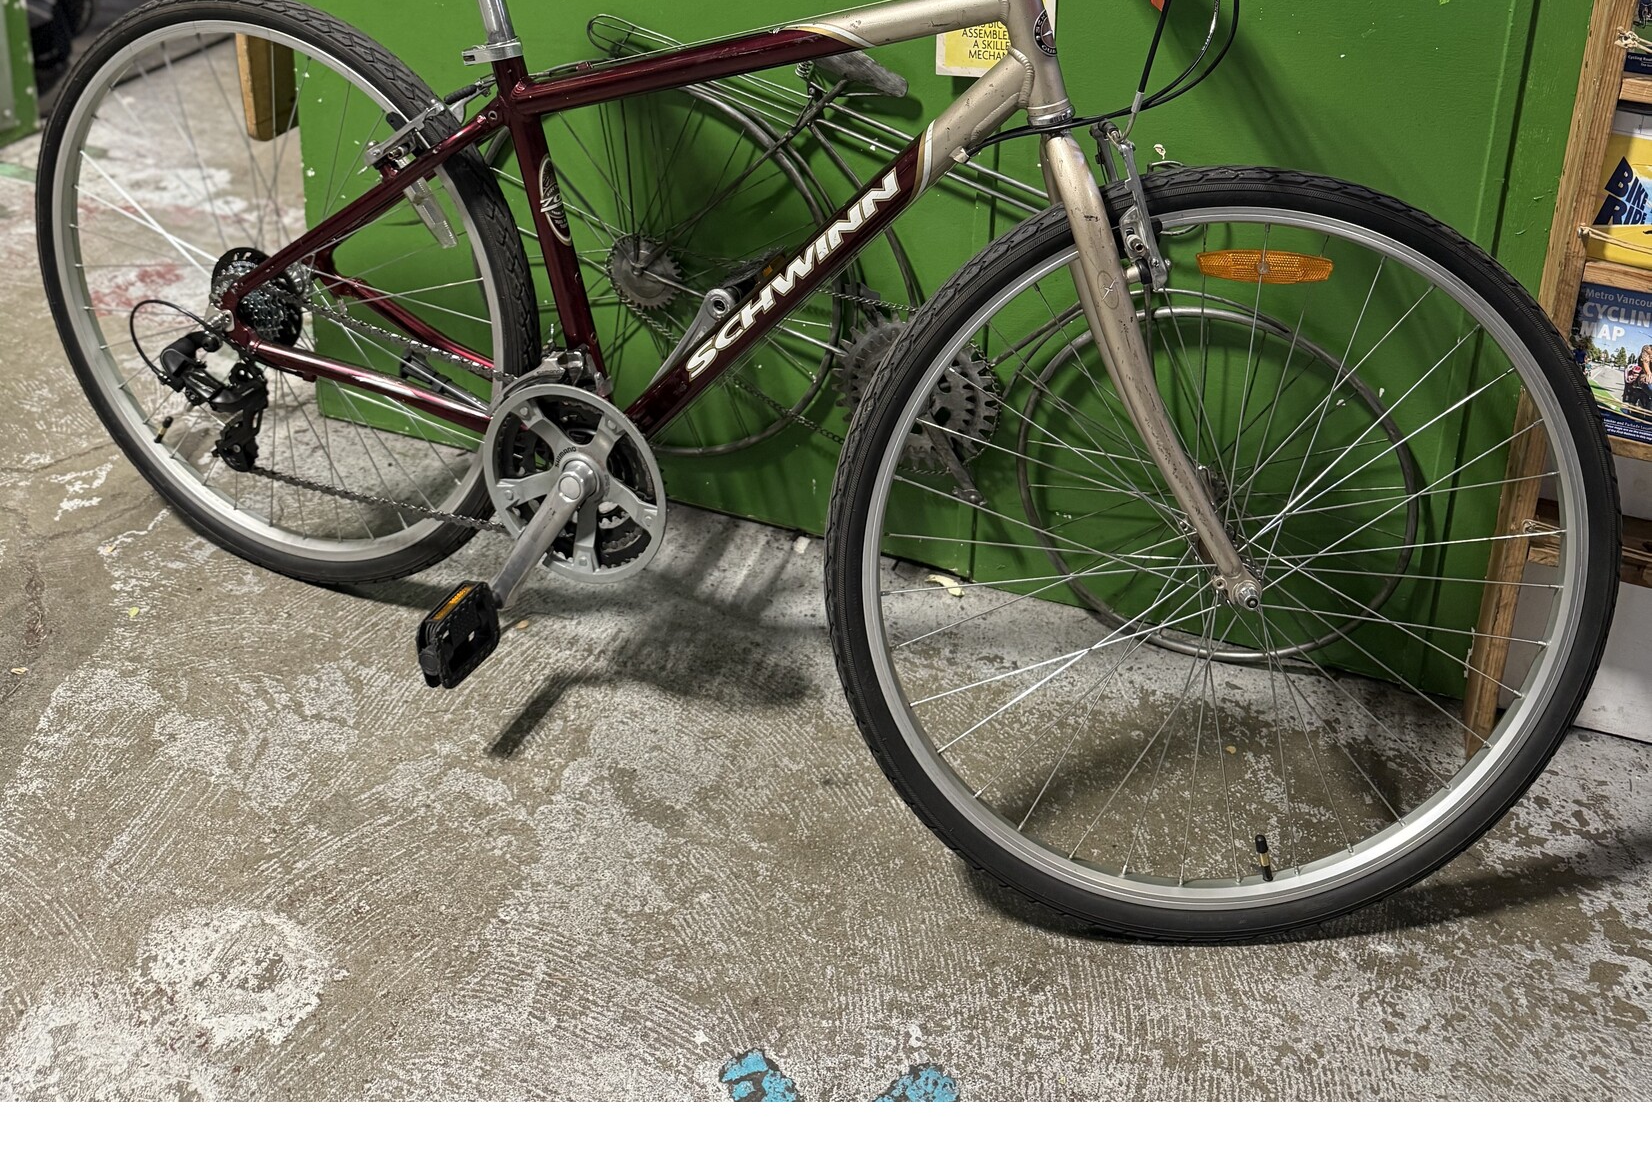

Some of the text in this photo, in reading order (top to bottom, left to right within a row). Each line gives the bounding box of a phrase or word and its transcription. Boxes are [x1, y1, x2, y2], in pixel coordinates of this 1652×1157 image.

[961, 28, 1008, 40] ASSEMBLE
[973, 40, 1010, 52] A SKILLE
[1604, 156, 1649, 212] BIKE
[1592, 193, 1647, 225] RIDE
[686, 167, 901, 382] SCHWINN
[1586, 288, 1615, 302] Metro
[1583, 302, 1652, 328] CYCLIN
[1579, 320, 1626, 342] MAP
[555, 446, 577, 468] SHIMANO
